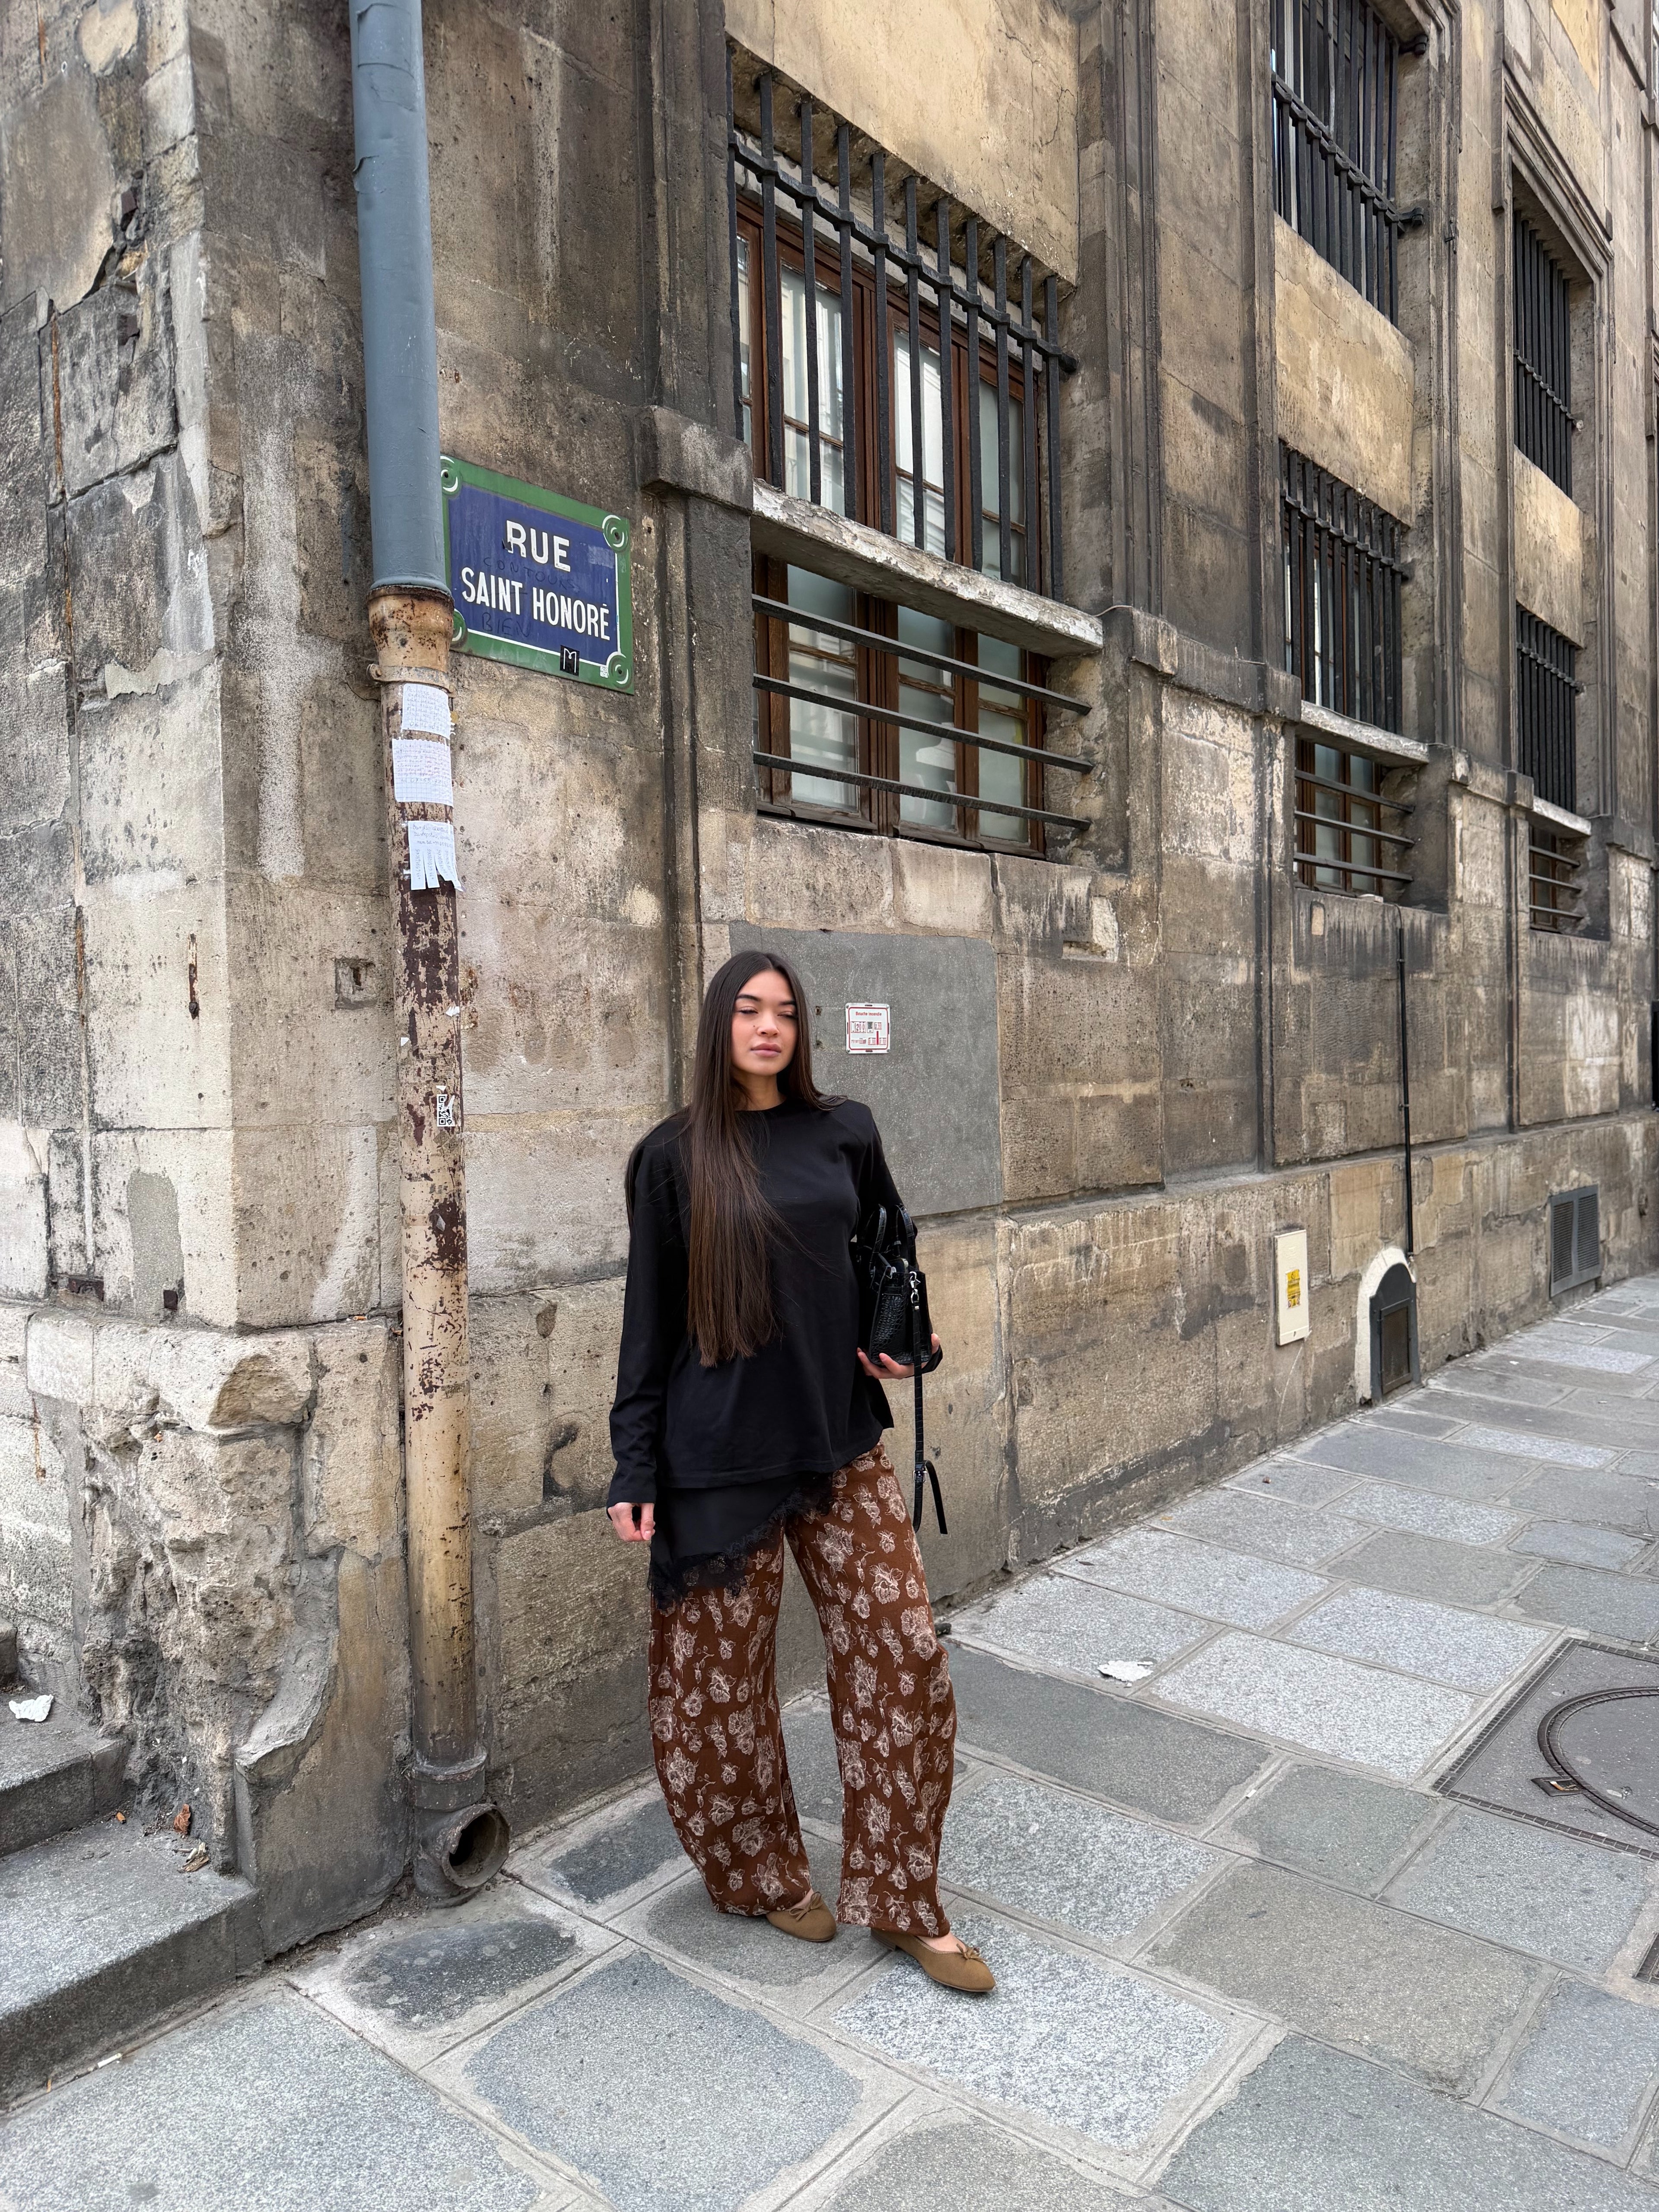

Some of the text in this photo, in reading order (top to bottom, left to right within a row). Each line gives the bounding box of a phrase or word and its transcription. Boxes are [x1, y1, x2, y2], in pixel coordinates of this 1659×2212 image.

[506, 520, 571, 572] RUE
[461, 567, 610, 640] SAINT HONORÉ
[482, 612, 531, 638] BIEN
